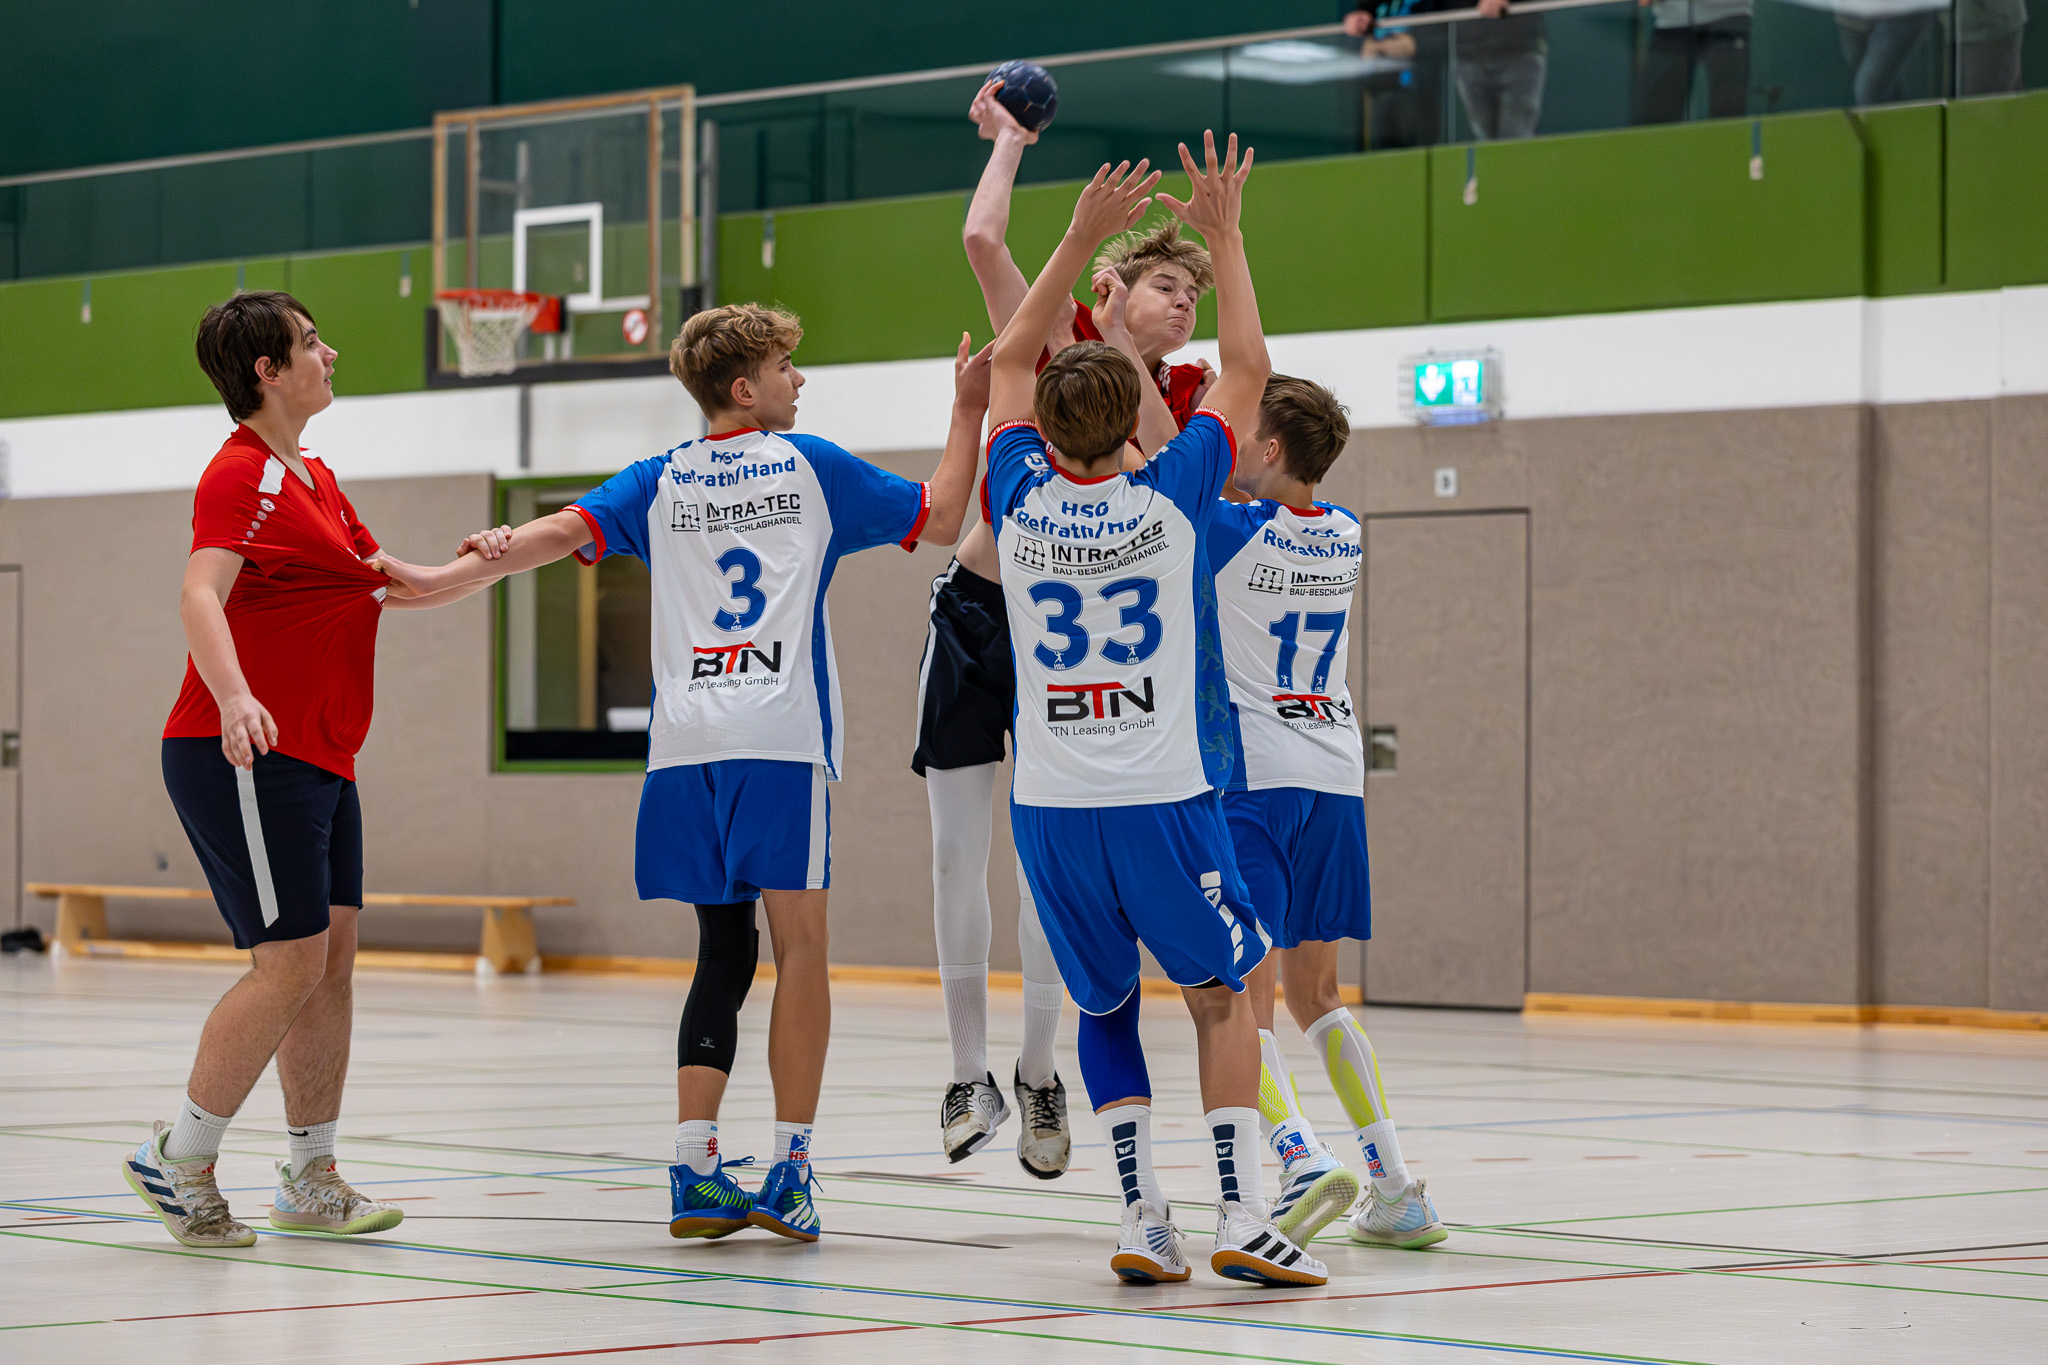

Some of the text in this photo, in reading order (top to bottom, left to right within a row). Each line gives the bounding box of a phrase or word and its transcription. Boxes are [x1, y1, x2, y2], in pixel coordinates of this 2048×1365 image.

[707, 494, 800, 520] INTRA-TEC
[1061, 501, 1109, 518] HSG
[708, 516, 802, 533] BAU-BSCHLAGHANDEL
[1016, 510, 1146, 539] Refrath/Ha
[1052, 541, 1170, 575] BAU-BESCHLAGHANDEL
[712, 547, 767, 632] 3
[1027, 576, 1163, 671] 33
[691, 641, 782, 680] BTN
[1269, 609, 1346, 694] 17
[688, 676, 779, 692] BTN Leasing GmbH
[1047, 676, 1155, 722] BTN
[1272, 694, 1351, 722] BTN
[1073, 724, 1116, 737] Leasing
[1119, 717, 1155, 732] GmbH
